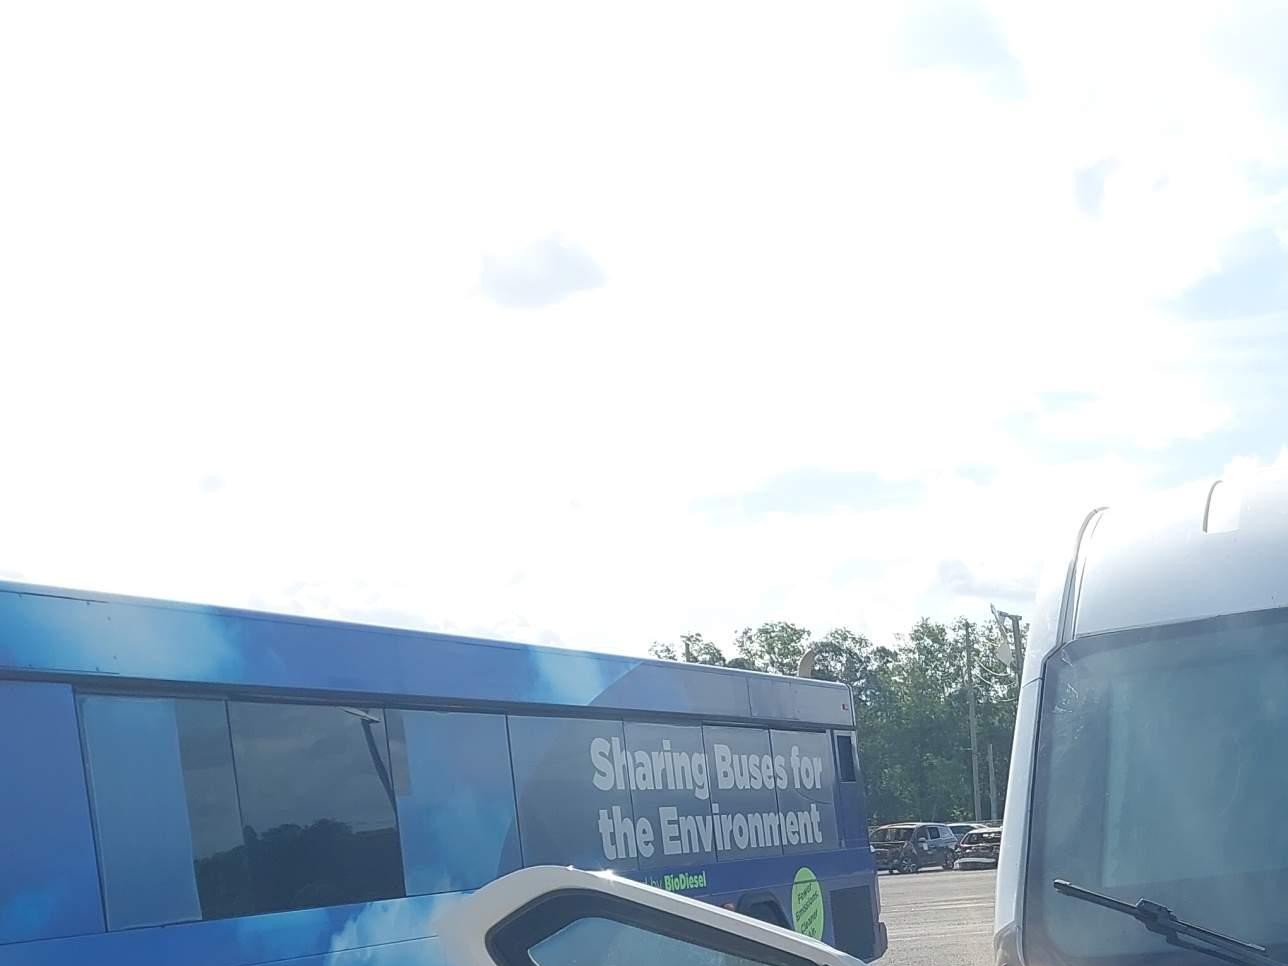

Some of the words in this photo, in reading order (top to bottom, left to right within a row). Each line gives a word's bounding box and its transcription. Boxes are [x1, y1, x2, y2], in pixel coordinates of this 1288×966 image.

[590, 737, 709, 799] Sharing
[714, 744, 788, 790] Buses
[791, 745, 824, 790] for
[598, 805, 655, 861] the
[659, 803, 823, 856] Environment
[664, 871, 707, 891] BioDiesel
